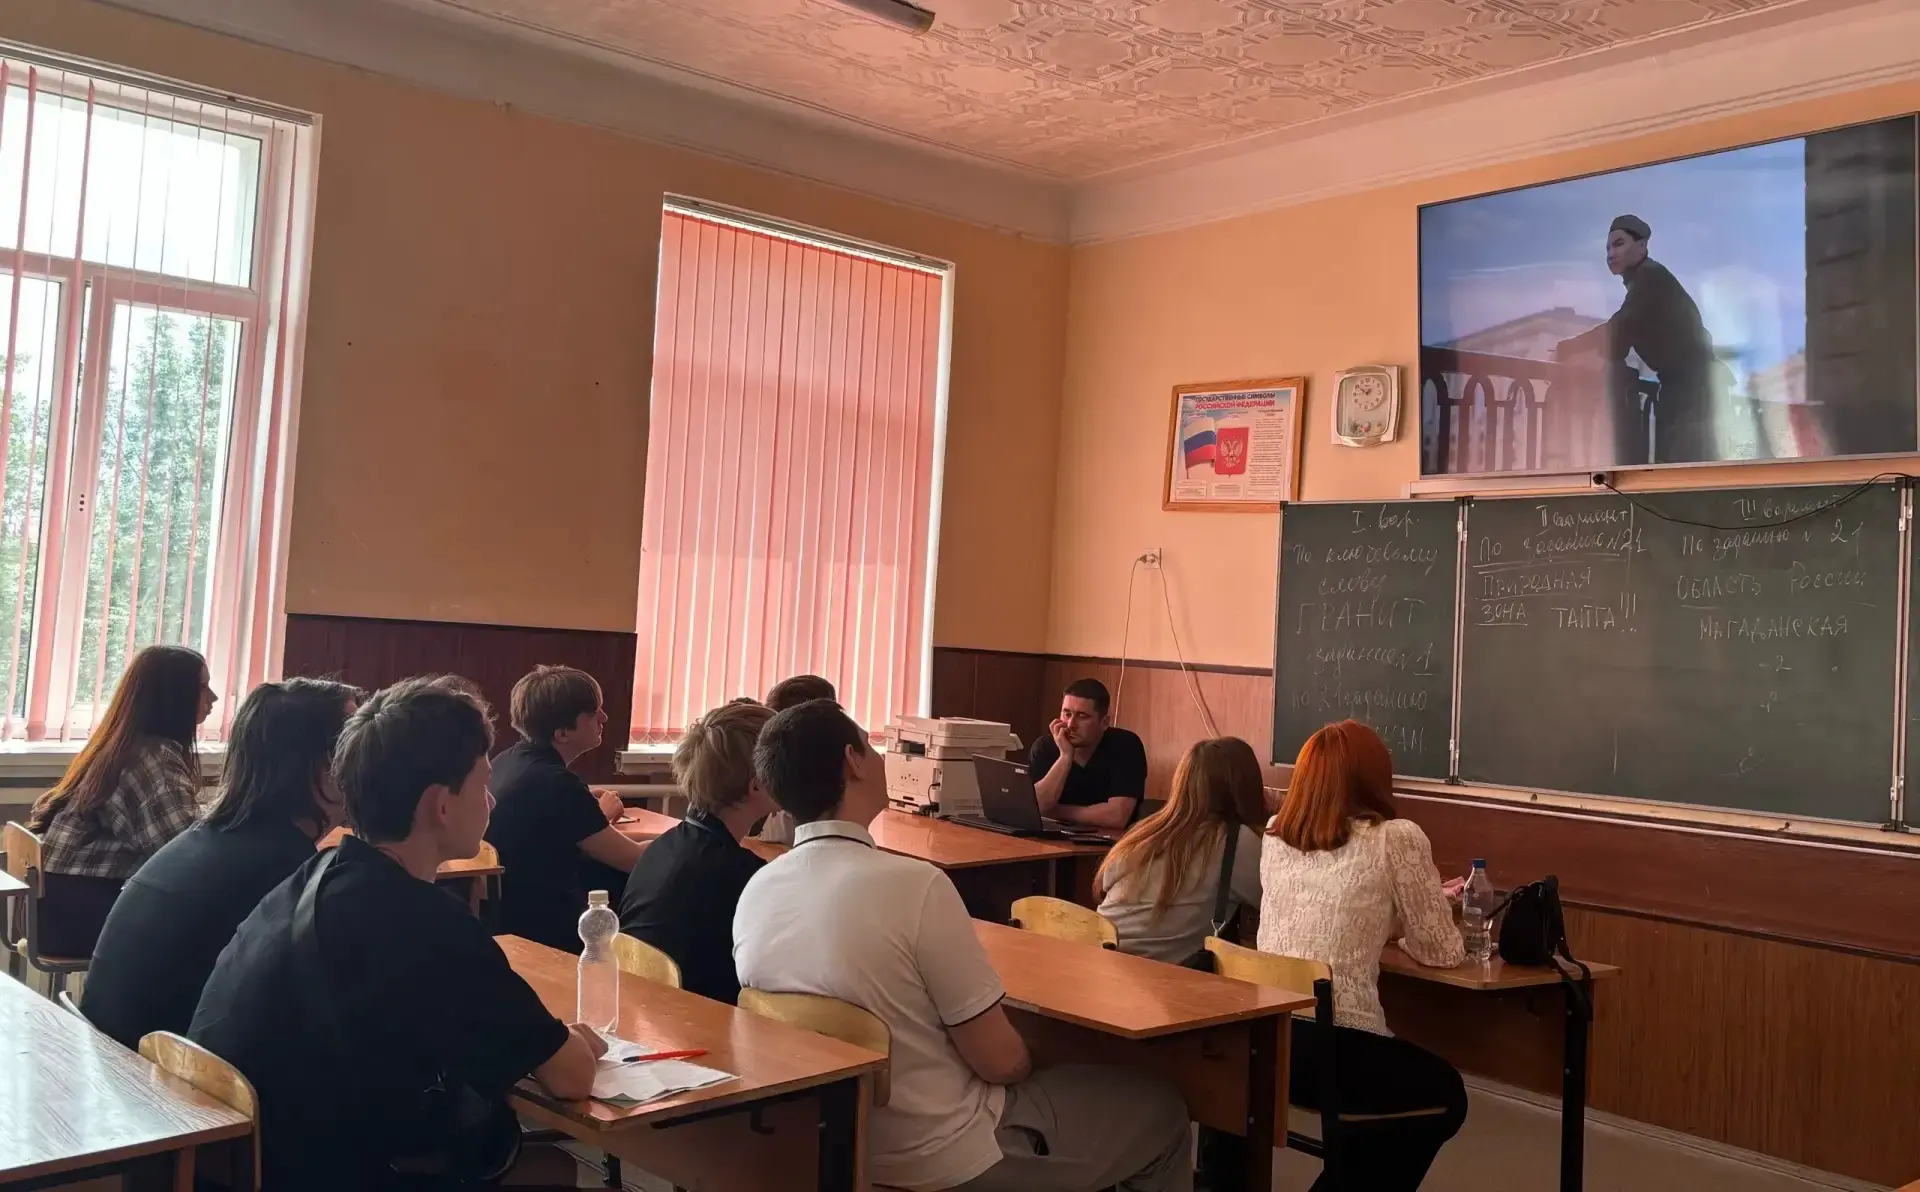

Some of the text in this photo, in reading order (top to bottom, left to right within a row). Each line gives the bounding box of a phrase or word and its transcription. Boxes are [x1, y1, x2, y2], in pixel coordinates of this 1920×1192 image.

[1195, 400, 1275, 409] РОССИЙСКОЙ ФЕДЕРАЦИИ
[1479, 536, 1502, 562] По
[1682, 533, 1703, 556] По
[1296, 598, 1426, 634] ГРАНИТ
[1481, 602, 1527, 623] ЗОНА
